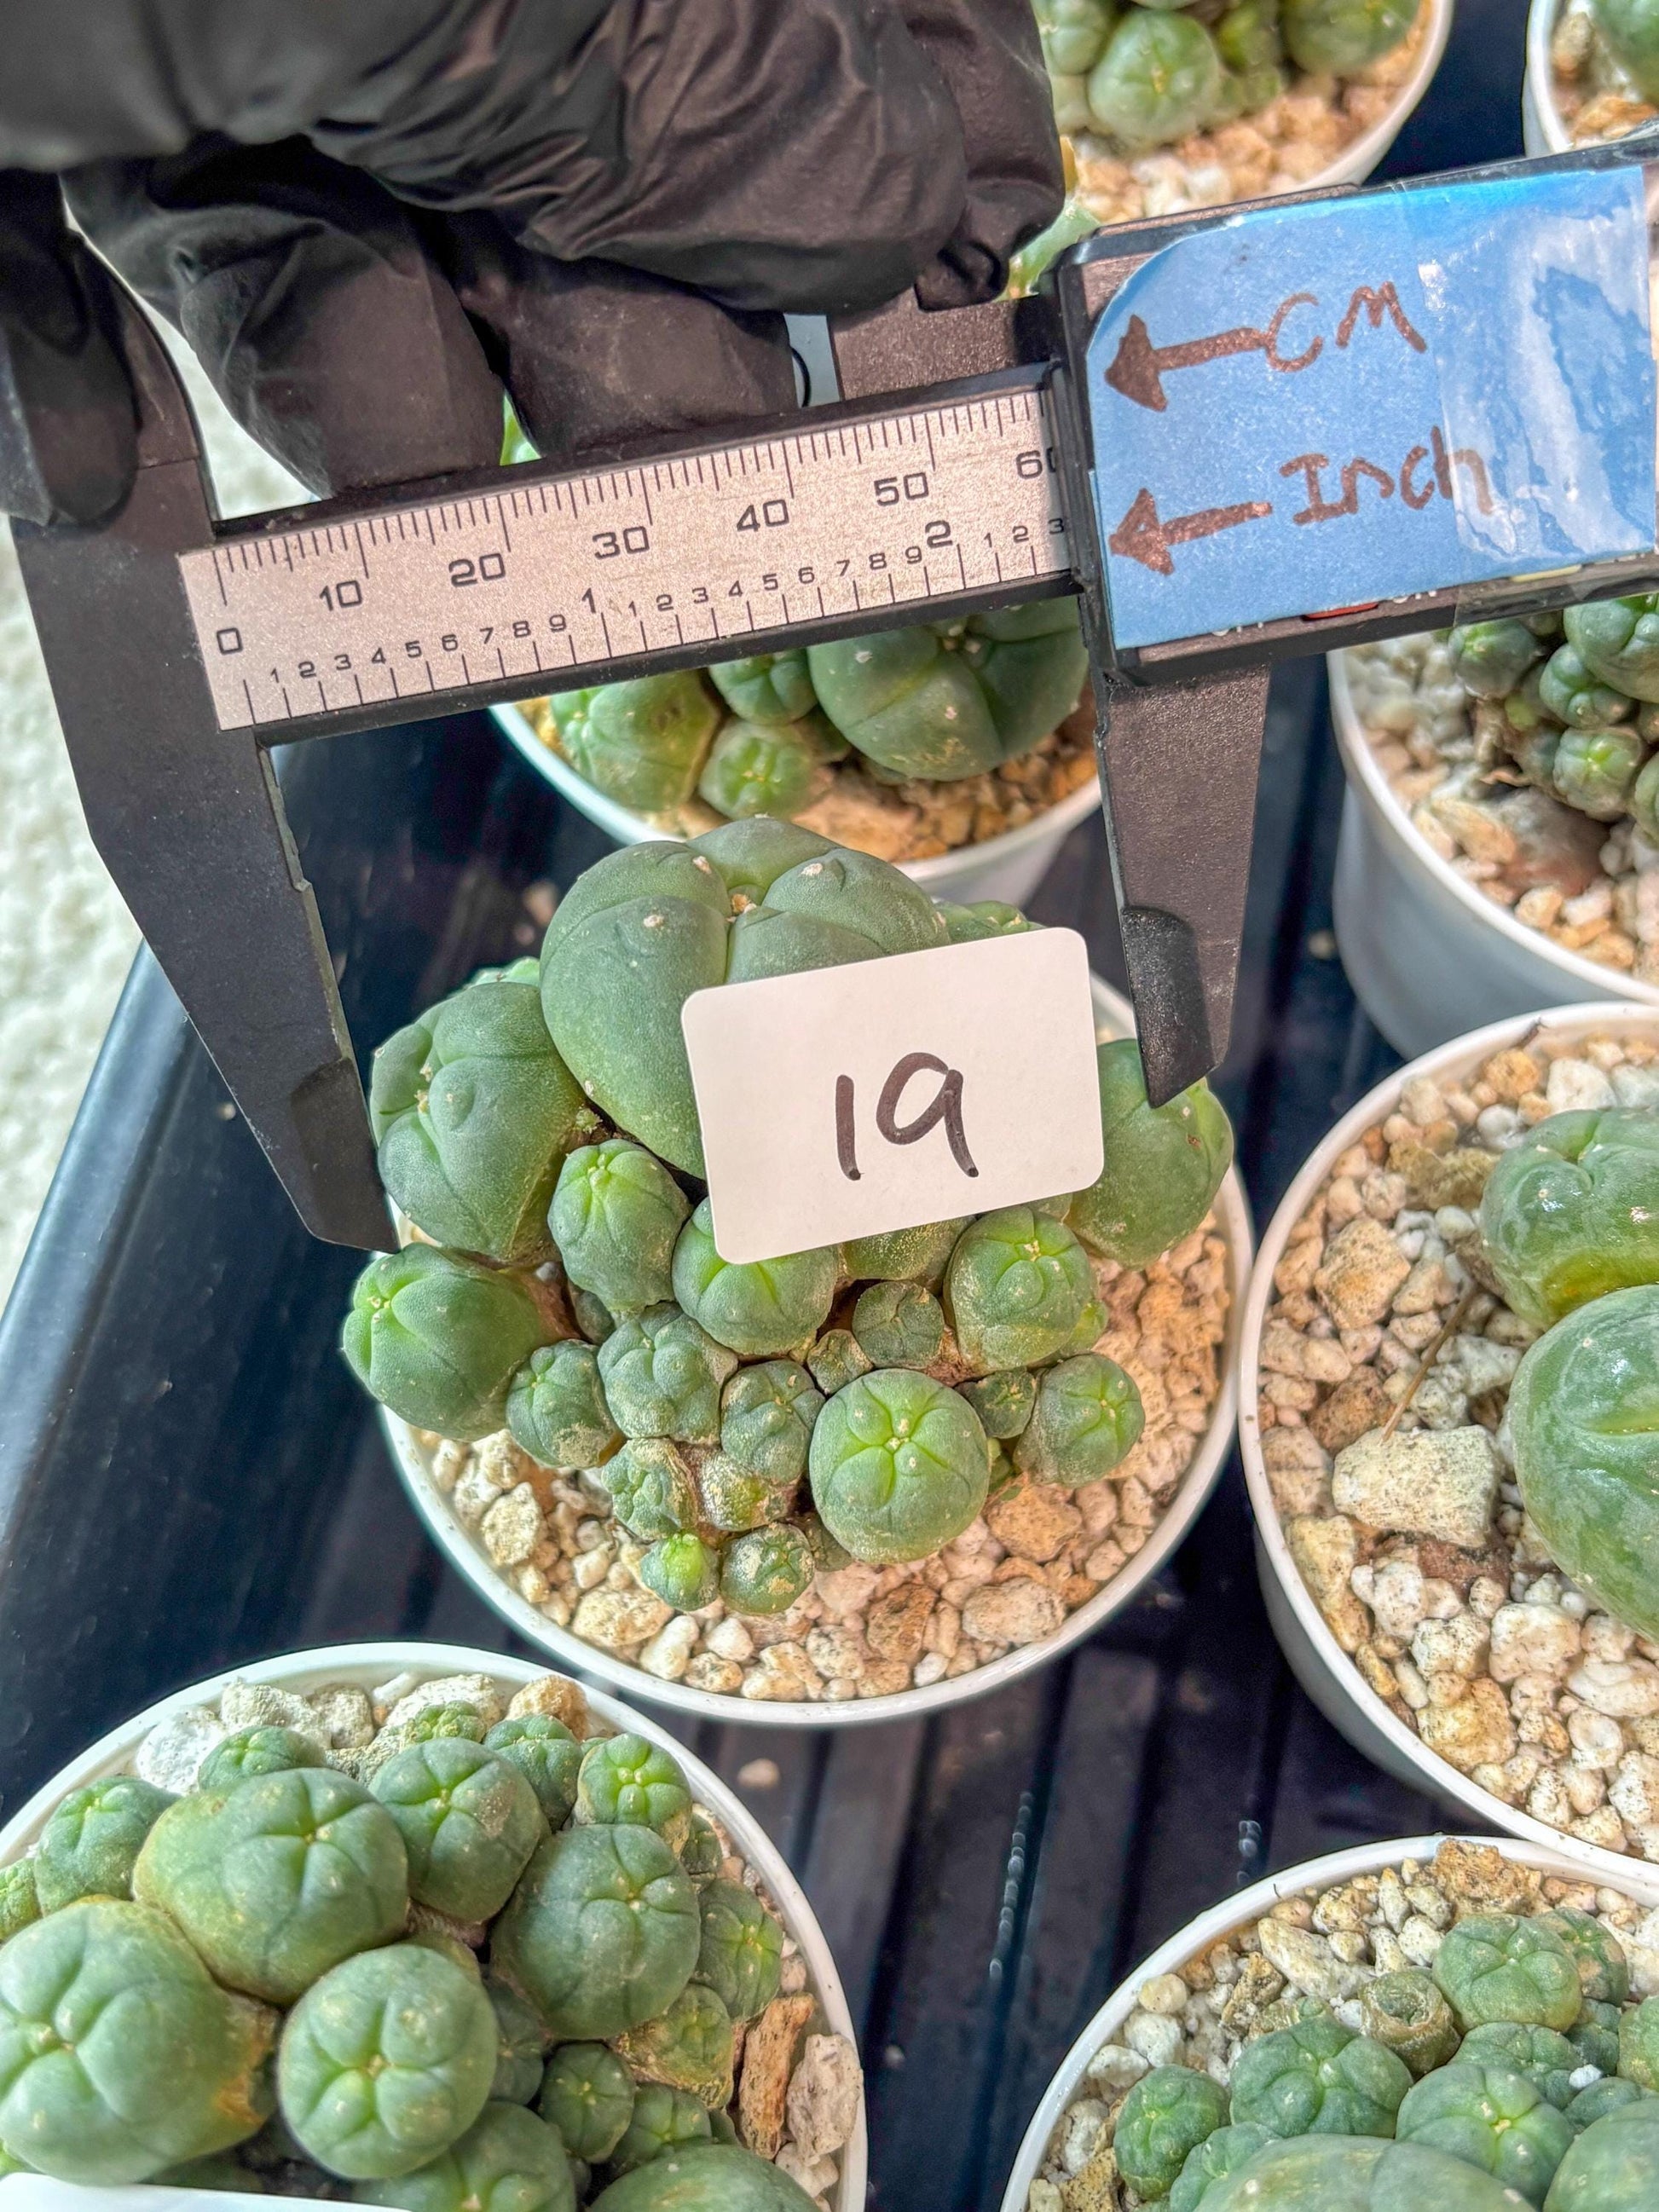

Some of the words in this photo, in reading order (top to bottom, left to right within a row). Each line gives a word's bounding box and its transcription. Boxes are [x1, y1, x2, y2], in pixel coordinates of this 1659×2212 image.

[216, 627, 243, 655] 0
[319, 580, 362, 611] 10
[448, 553, 506, 586] 20
[592, 526, 650, 559] 30
[737, 500, 789, 532] 40
[874, 472, 928, 505] 50
[270, 668, 279, 683] 1
[298, 661, 316, 679] 2
[334, 654, 351, 670] 3
[372, 647, 386, 664] 4
[405, 641, 422, 658] 5
[442, 634, 459, 652] 6
[480, 627, 494, 644] 7
[512, 621, 531, 638] 8
[549, 615, 567, 632] 9
[581, 587, 596, 614] 1
[628, 601, 637, 616] 1
[656, 594, 673, 611] 2
[692, 587, 709, 604] 3
[728, 580, 743, 598] 4
[762, 574, 778, 591] 5
[798, 567, 815, 584] 6
[836, 560, 850, 577] 7
[869, 553, 887, 570] 8
[905, 546, 922, 564] 9
[925, 520, 953, 549] 2
[983, 533, 992, 547] 1
[1012, 526, 1030, 543] 2
[835, 1052, 980, 1181] 19
